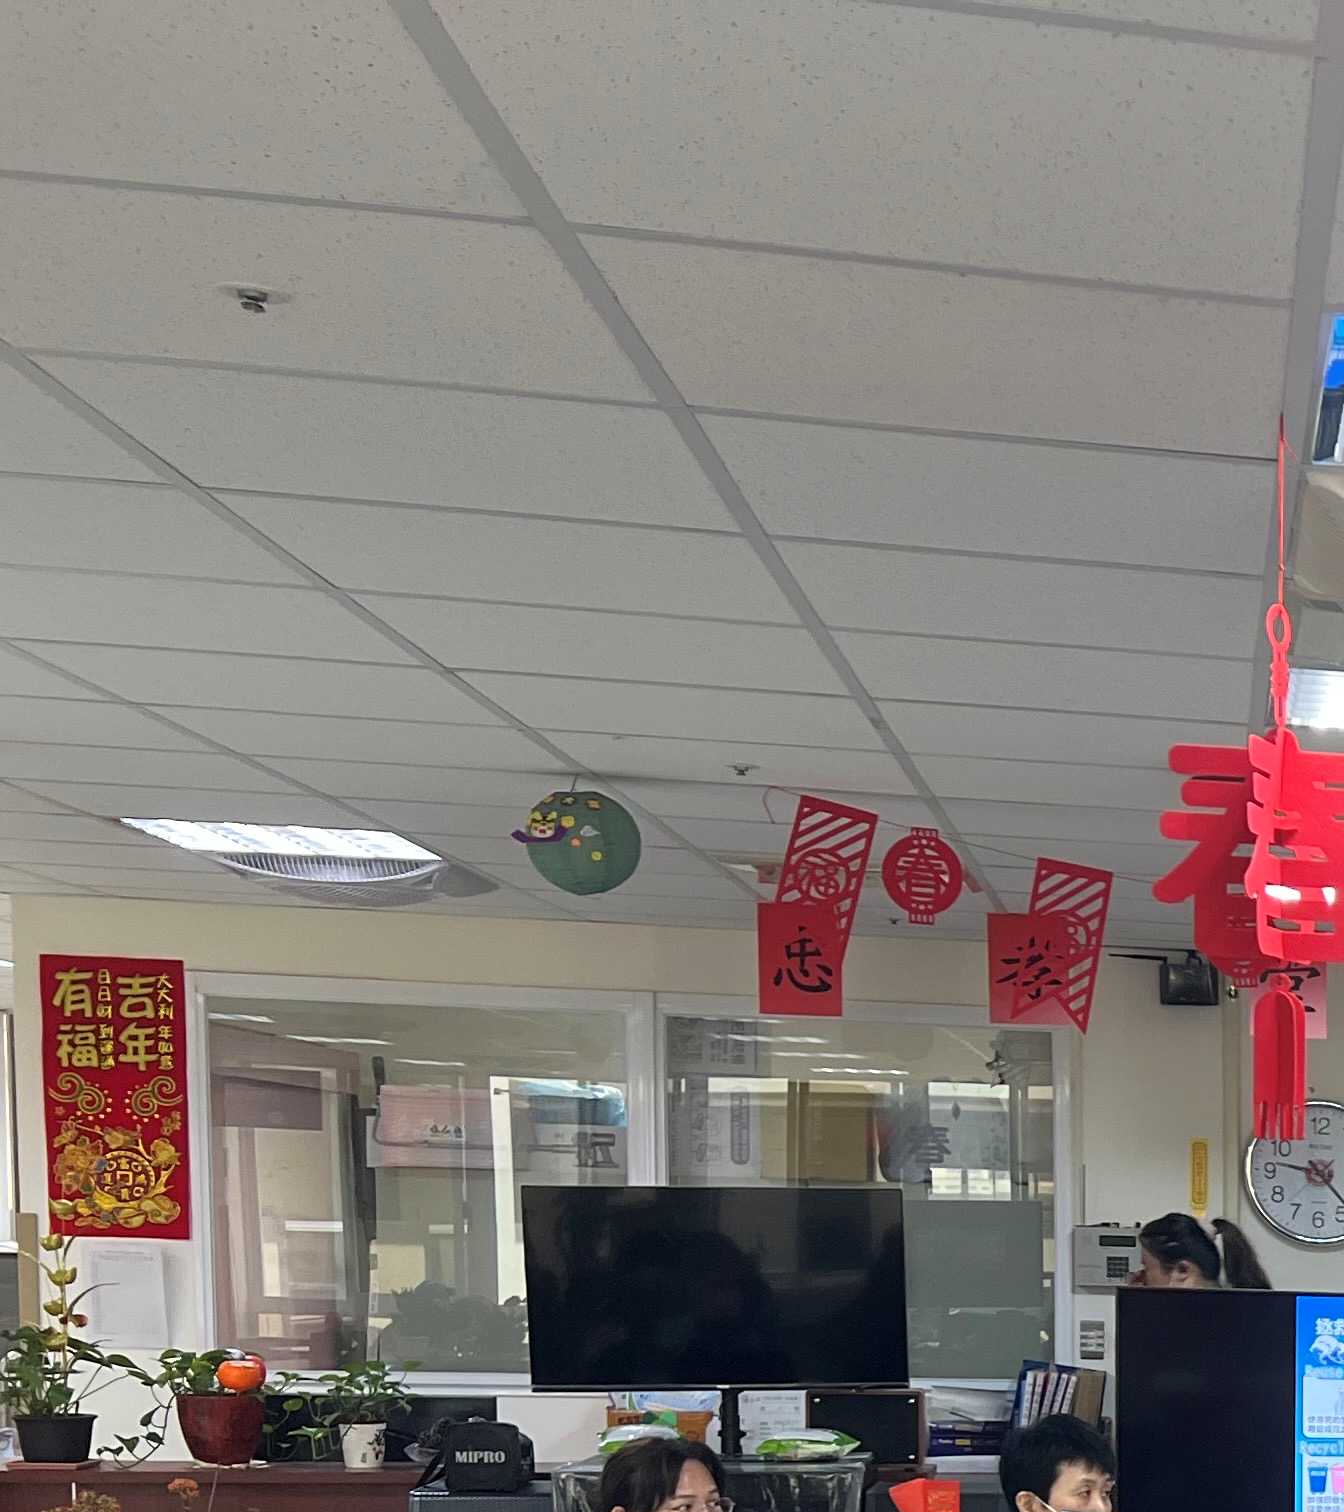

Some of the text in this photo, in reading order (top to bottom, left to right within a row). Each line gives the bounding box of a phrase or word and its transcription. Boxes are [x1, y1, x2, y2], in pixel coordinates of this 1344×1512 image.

[1311, 1117, 1331, 1135] 12
[1264, 1162, 1276, 1179] 9
[1271, 1185, 1284, 1203] 8
[1290, 1203, 1302, 1219] 7
[1312, 1211, 1325, 1228] 6
[455, 1449, 506, 1464] MIPRO
